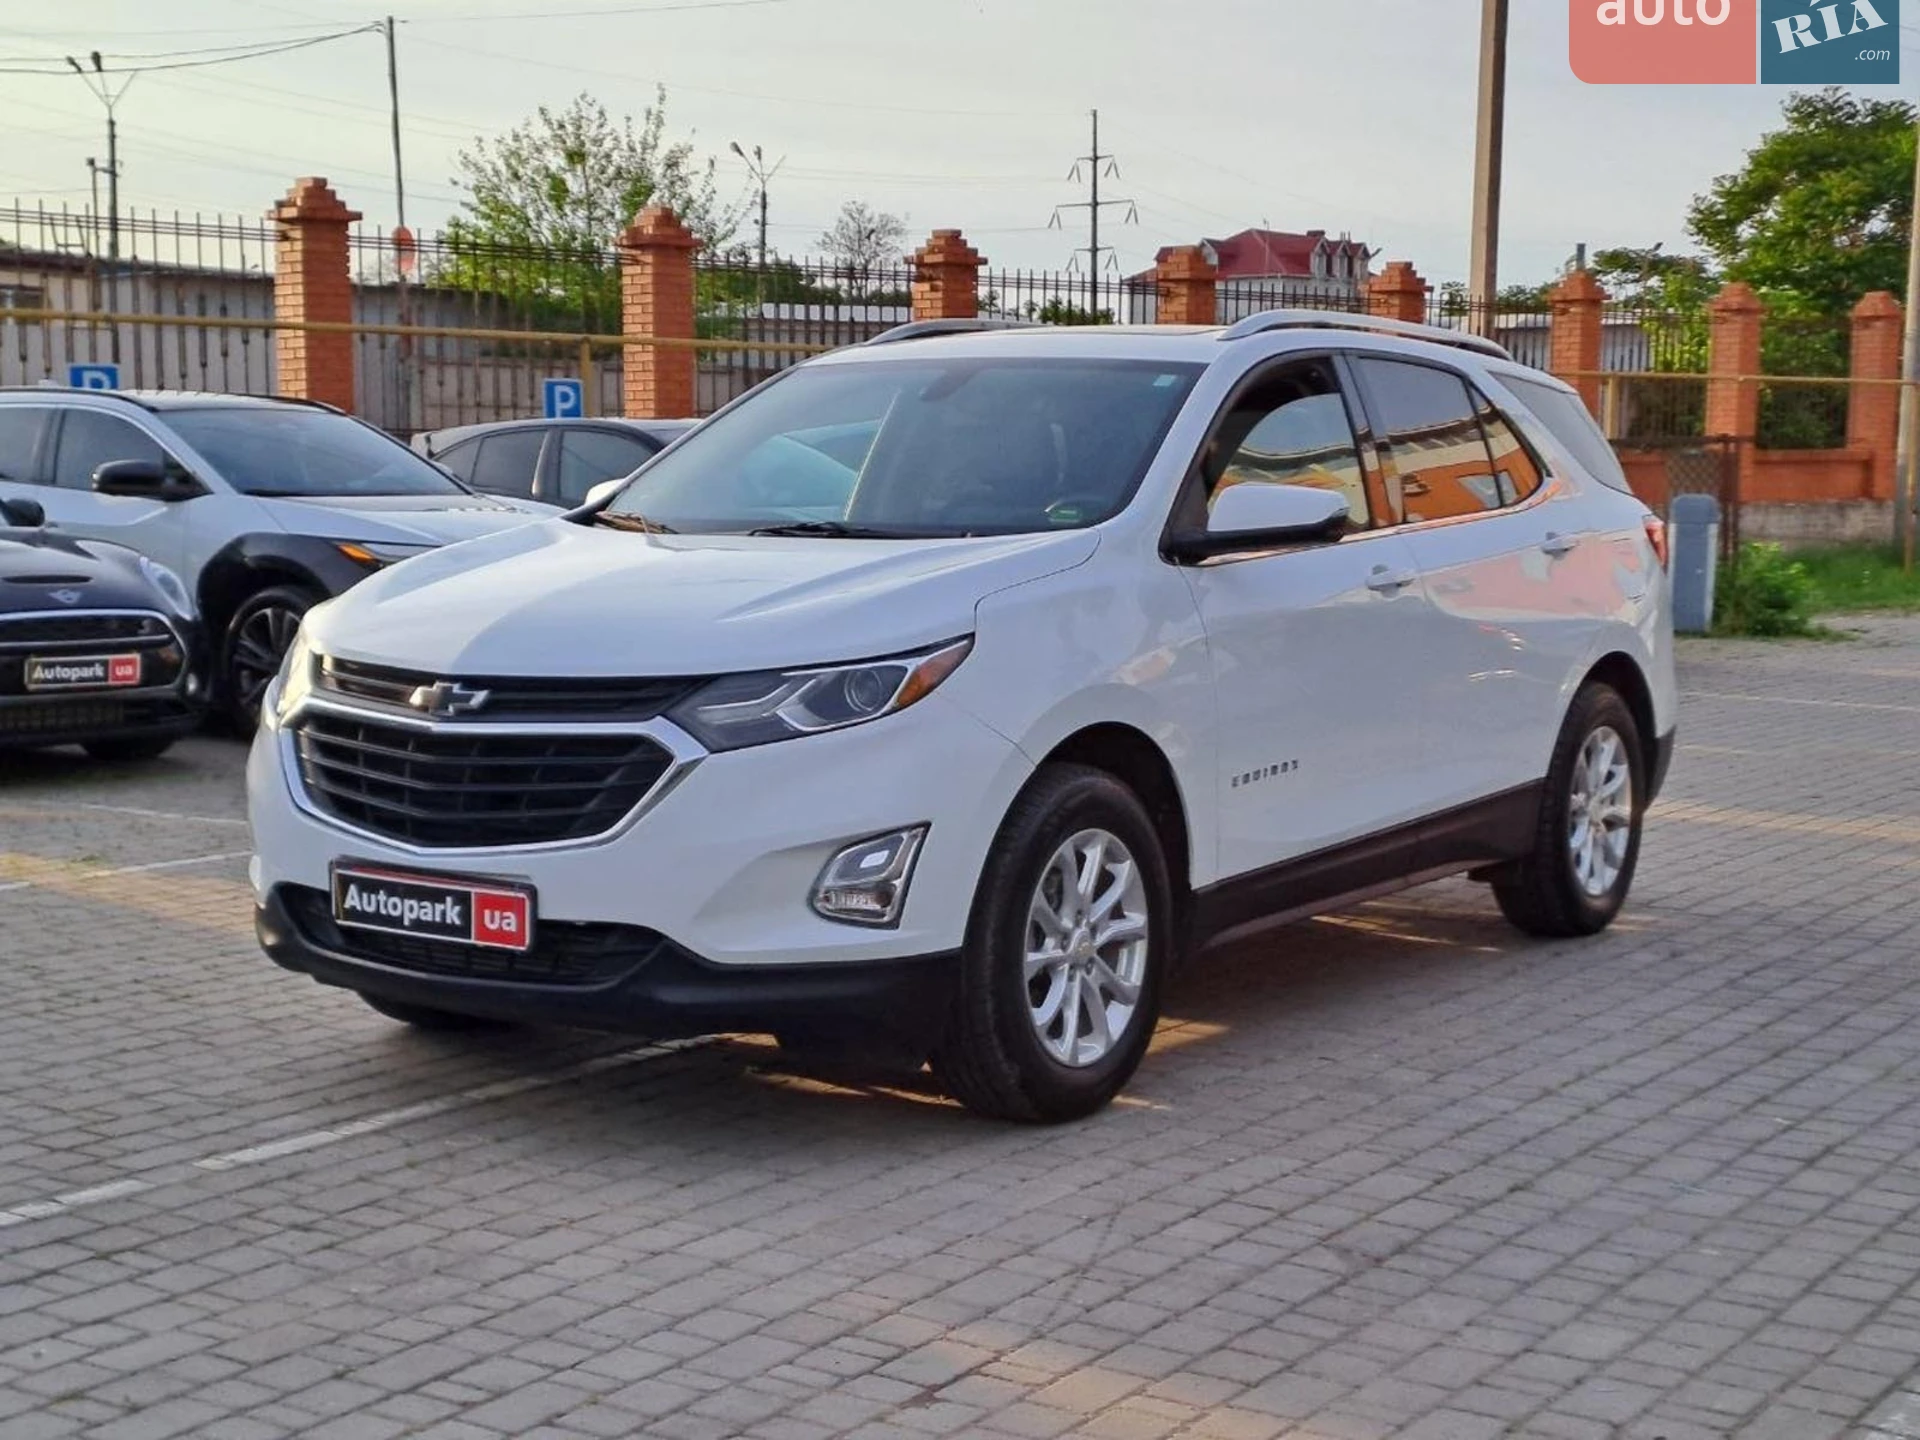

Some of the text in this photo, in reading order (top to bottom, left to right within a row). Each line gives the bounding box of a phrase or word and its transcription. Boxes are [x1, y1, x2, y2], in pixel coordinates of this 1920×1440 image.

[554, 385, 576, 418] P
[32, 663, 134, 681] Autopark ua
[343, 883, 517, 932] Autopark ua
